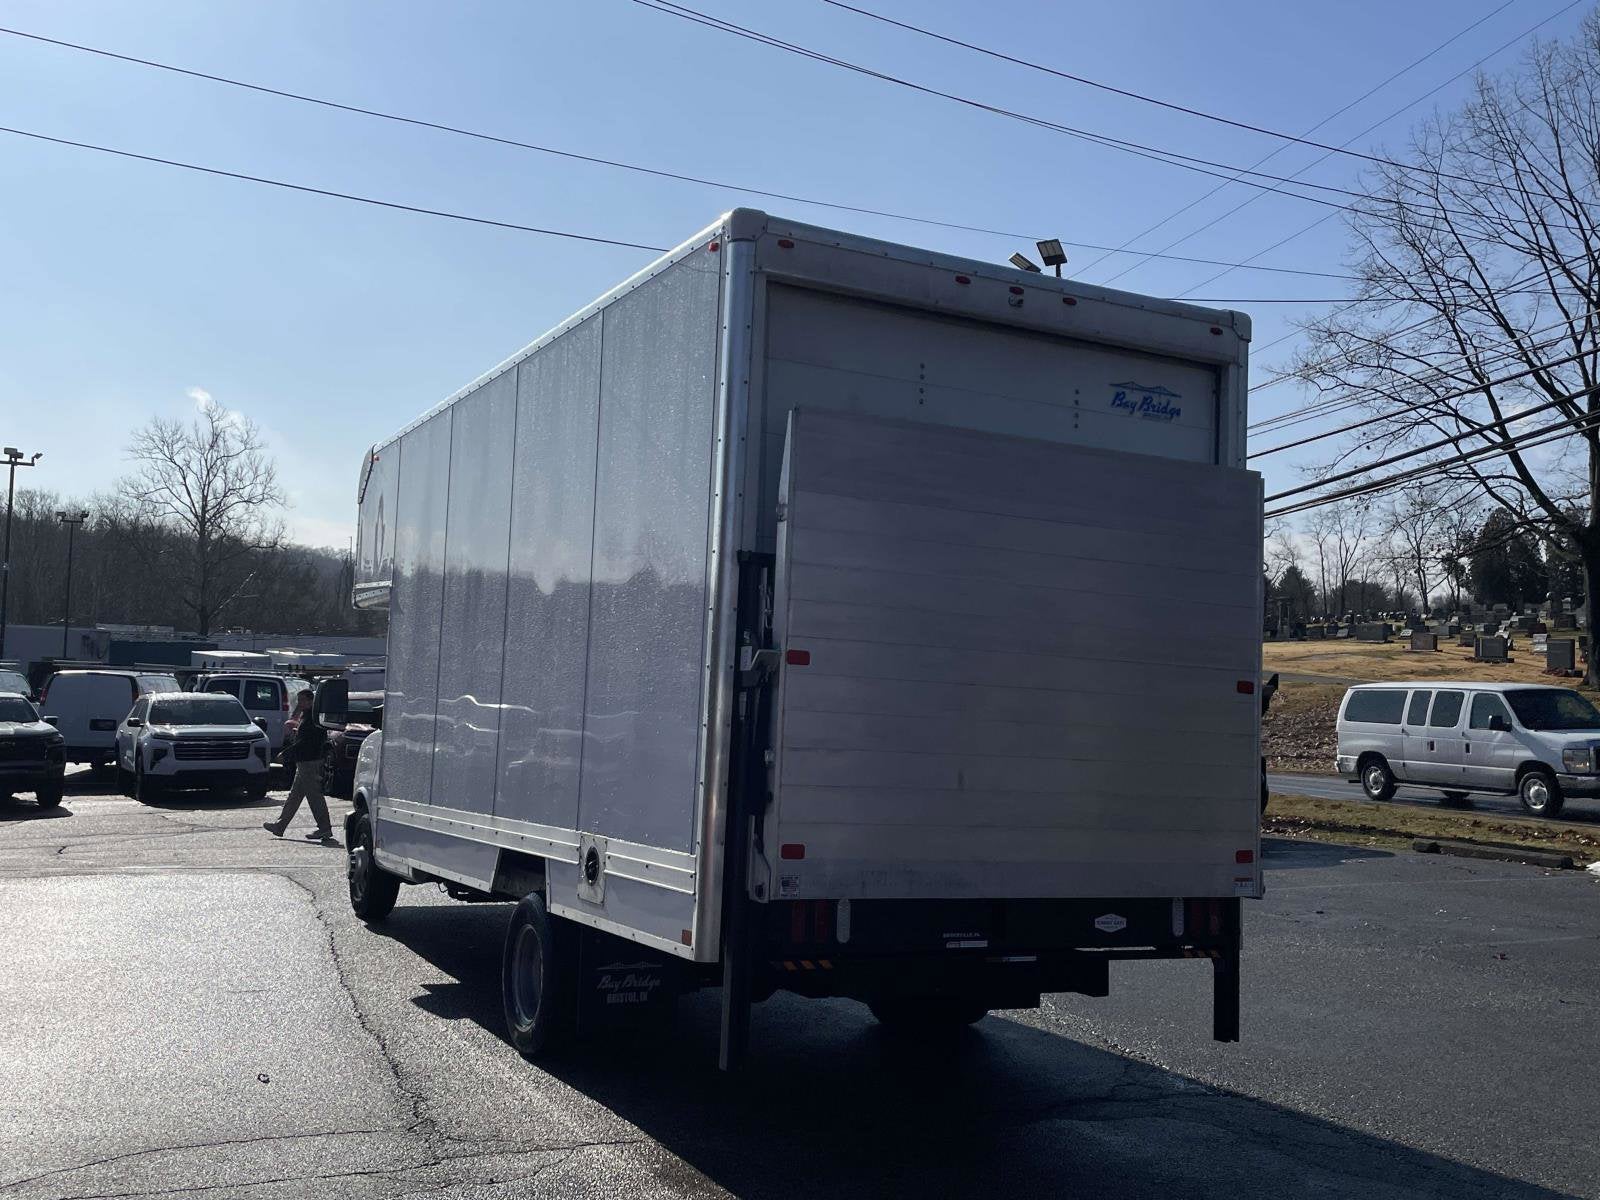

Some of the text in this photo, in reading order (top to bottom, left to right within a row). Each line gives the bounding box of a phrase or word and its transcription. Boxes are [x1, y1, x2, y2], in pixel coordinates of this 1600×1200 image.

[1110, 391, 1138, 415] Bay
[1137, 395, 1182, 420] Bridge
[597, 973, 661, 991] Bay Bridge
